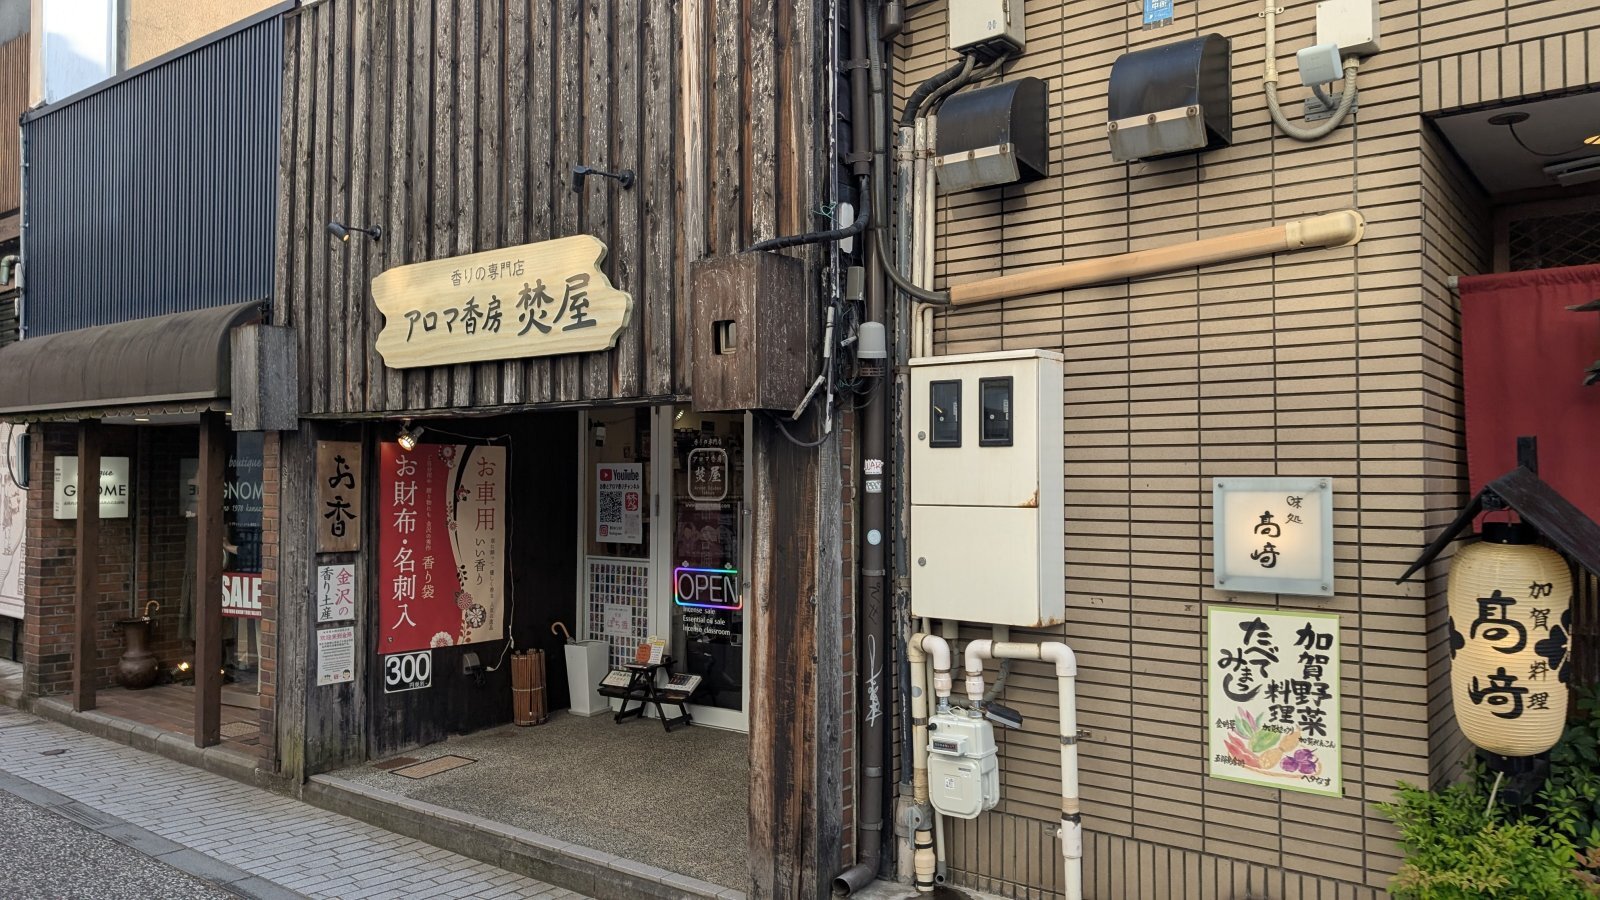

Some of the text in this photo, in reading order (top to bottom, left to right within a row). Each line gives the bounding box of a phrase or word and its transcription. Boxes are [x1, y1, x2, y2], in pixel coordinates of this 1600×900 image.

[450, 259, 525, 287] 香りの専門店
[404, 272, 597, 343] アロマ香房 焚屋
[228, 455, 262, 473] boutique
[613, 468, 640, 480] YouTube
[695, 465, 722, 483] 焚屋
[63, 484, 127, 497] GME
[324, 454, 358, 538] お香
[475, 456, 496, 532] お車用
[1285, 495, 1304, 525] 味処
[392, 454, 418, 630] お財布・名刺入
[474, 537, 486, 586] いい香り
[222, 575, 262, 609] SALE
[319, 566, 334, 621] 香り土産
[335, 567, 353, 616] 金沢の
[421, 555, 435, 599] 香り袋
[677, 573, 739, 604] OPEN
[682, 606, 703, 614] Incense
[682, 615, 705, 623] Essential
[682, 624, 731, 636] Incense classroom
[1239, 616, 1280, 679] たべて
[1527, 580, 1553, 711] 加賀料理
[386, 653, 430, 686] 300
[1292, 622, 1334, 737] 加賀野菜
[1265, 678, 1293, 725] 料理
